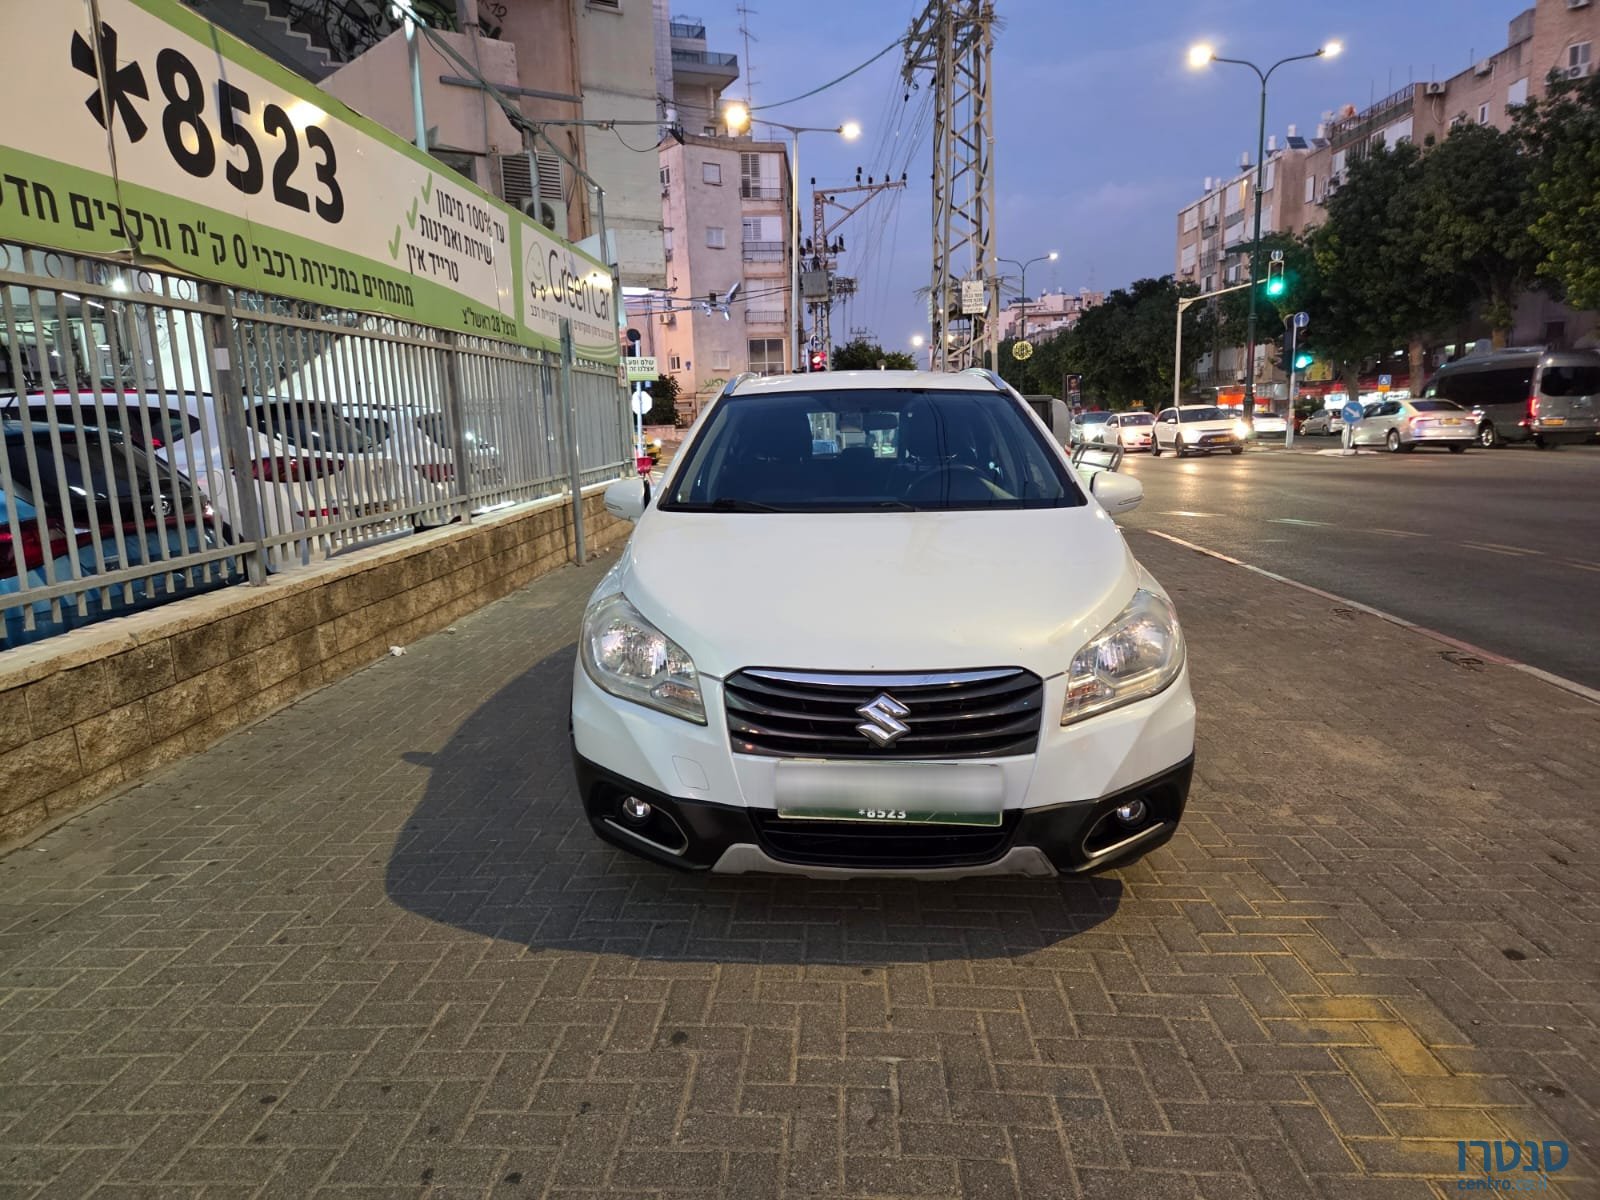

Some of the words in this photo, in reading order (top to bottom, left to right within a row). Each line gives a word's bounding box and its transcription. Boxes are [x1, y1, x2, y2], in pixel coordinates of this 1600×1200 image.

[0, 174, 59, 223] חד
[436, 189, 465, 223] מימון
[69, 192, 171, 250] ורכבים
[420, 214, 462, 253] ואמינות
[466, 204, 493, 237] 100%
[493, 221, 505, 243] עד
[178, 220, 227, 265] ק"מ
[233, 234, 248, 269] 0
[464, 235, 492, 265] שירות
[252, 245, 297, 281] רכבי
[300, 257, 361, 294] במכירת
[406, 244, 426, 275] אין
[429, 252, 459, 283] טרייד
[362, 274, 414, 307] מתמחים
[549, 249, 591, 313] Green
[592, 281, 610, 321] Car
[462, 307, 491, 329] ראשל"צ
[491, 314, 501, 333] 28
[502, 317, 518, 338] הרצל
